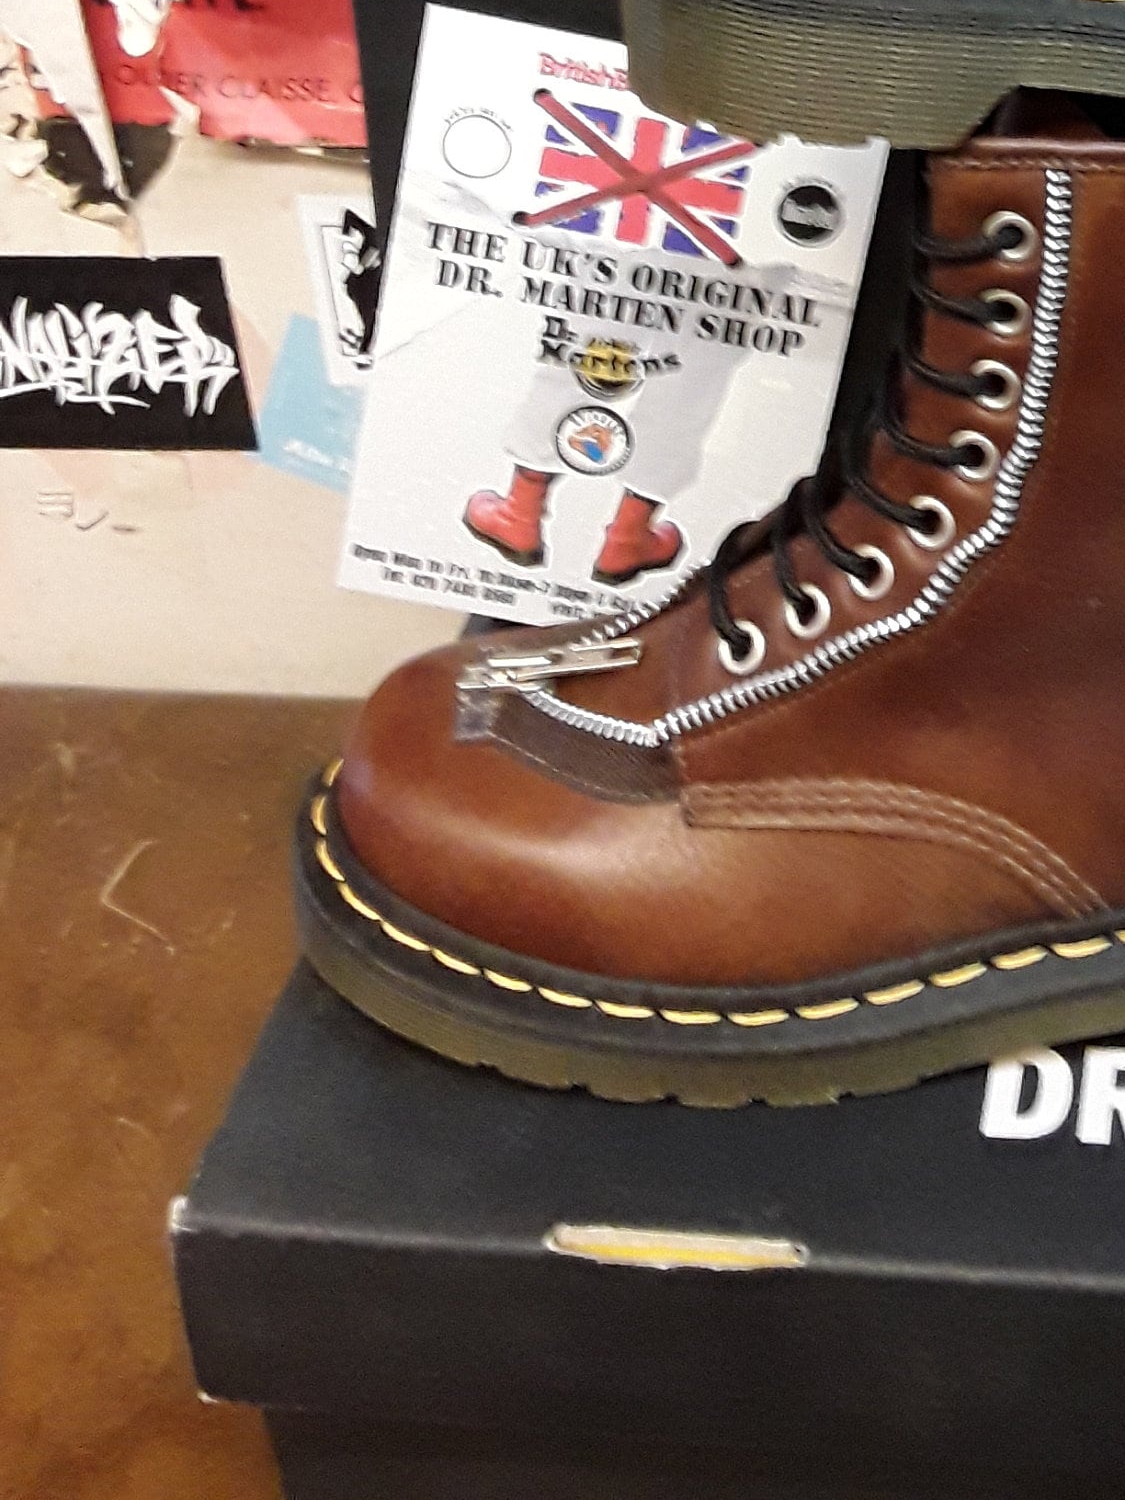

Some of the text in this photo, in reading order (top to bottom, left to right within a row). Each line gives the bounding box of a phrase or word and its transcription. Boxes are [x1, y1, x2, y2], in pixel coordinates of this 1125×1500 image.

[426, 221, 821, 328] THE UK'S ORIGINAL
[434, 259, 805, 357] DR. MARTEN SHOP
